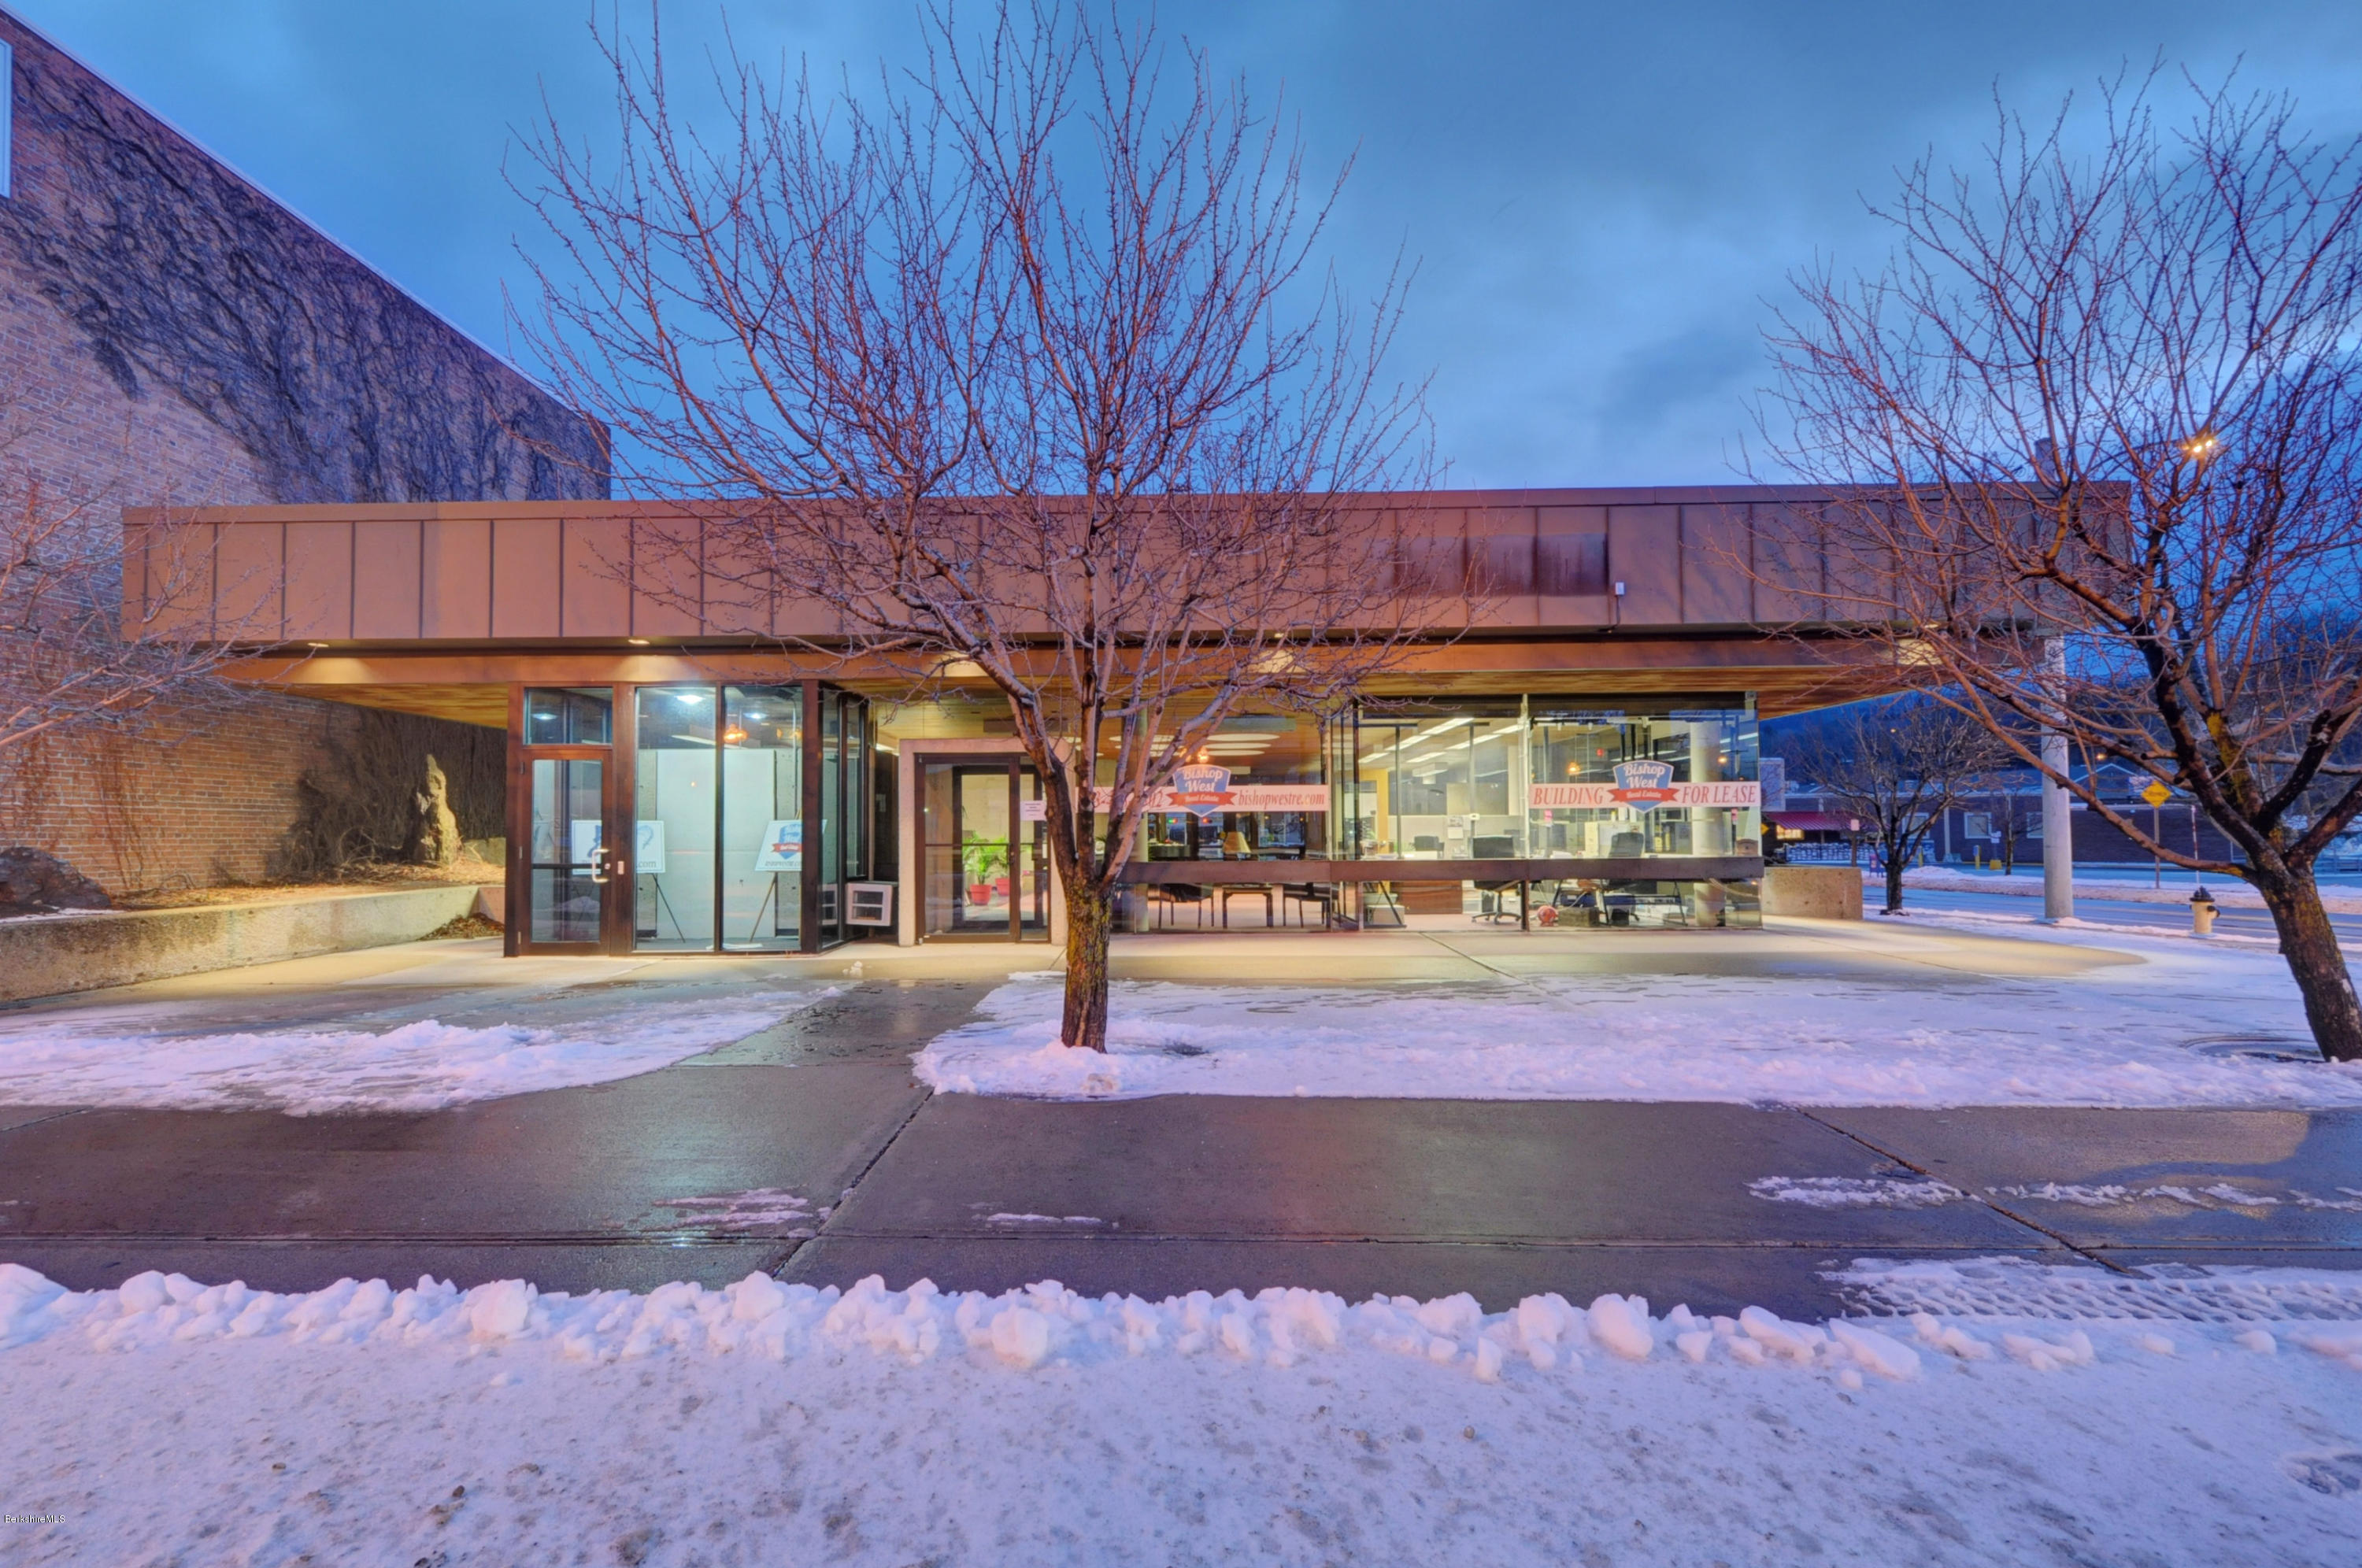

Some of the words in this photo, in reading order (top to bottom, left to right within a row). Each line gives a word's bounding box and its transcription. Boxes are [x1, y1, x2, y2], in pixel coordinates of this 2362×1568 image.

[1183, 767, 1223, 782] Bishop
[1623, 764, 1665, 778] Bishop
[1185, 780, 1216, 792] West
[1627, 776, 1657, 788] West
[1238, 789, 1325, 809] bishopwestre.com
[1534, 787, 1604, 804] BUILDING
[1682, 786, 1709, 803] FOR
[1713, 785, 1757, 803] LEASE
